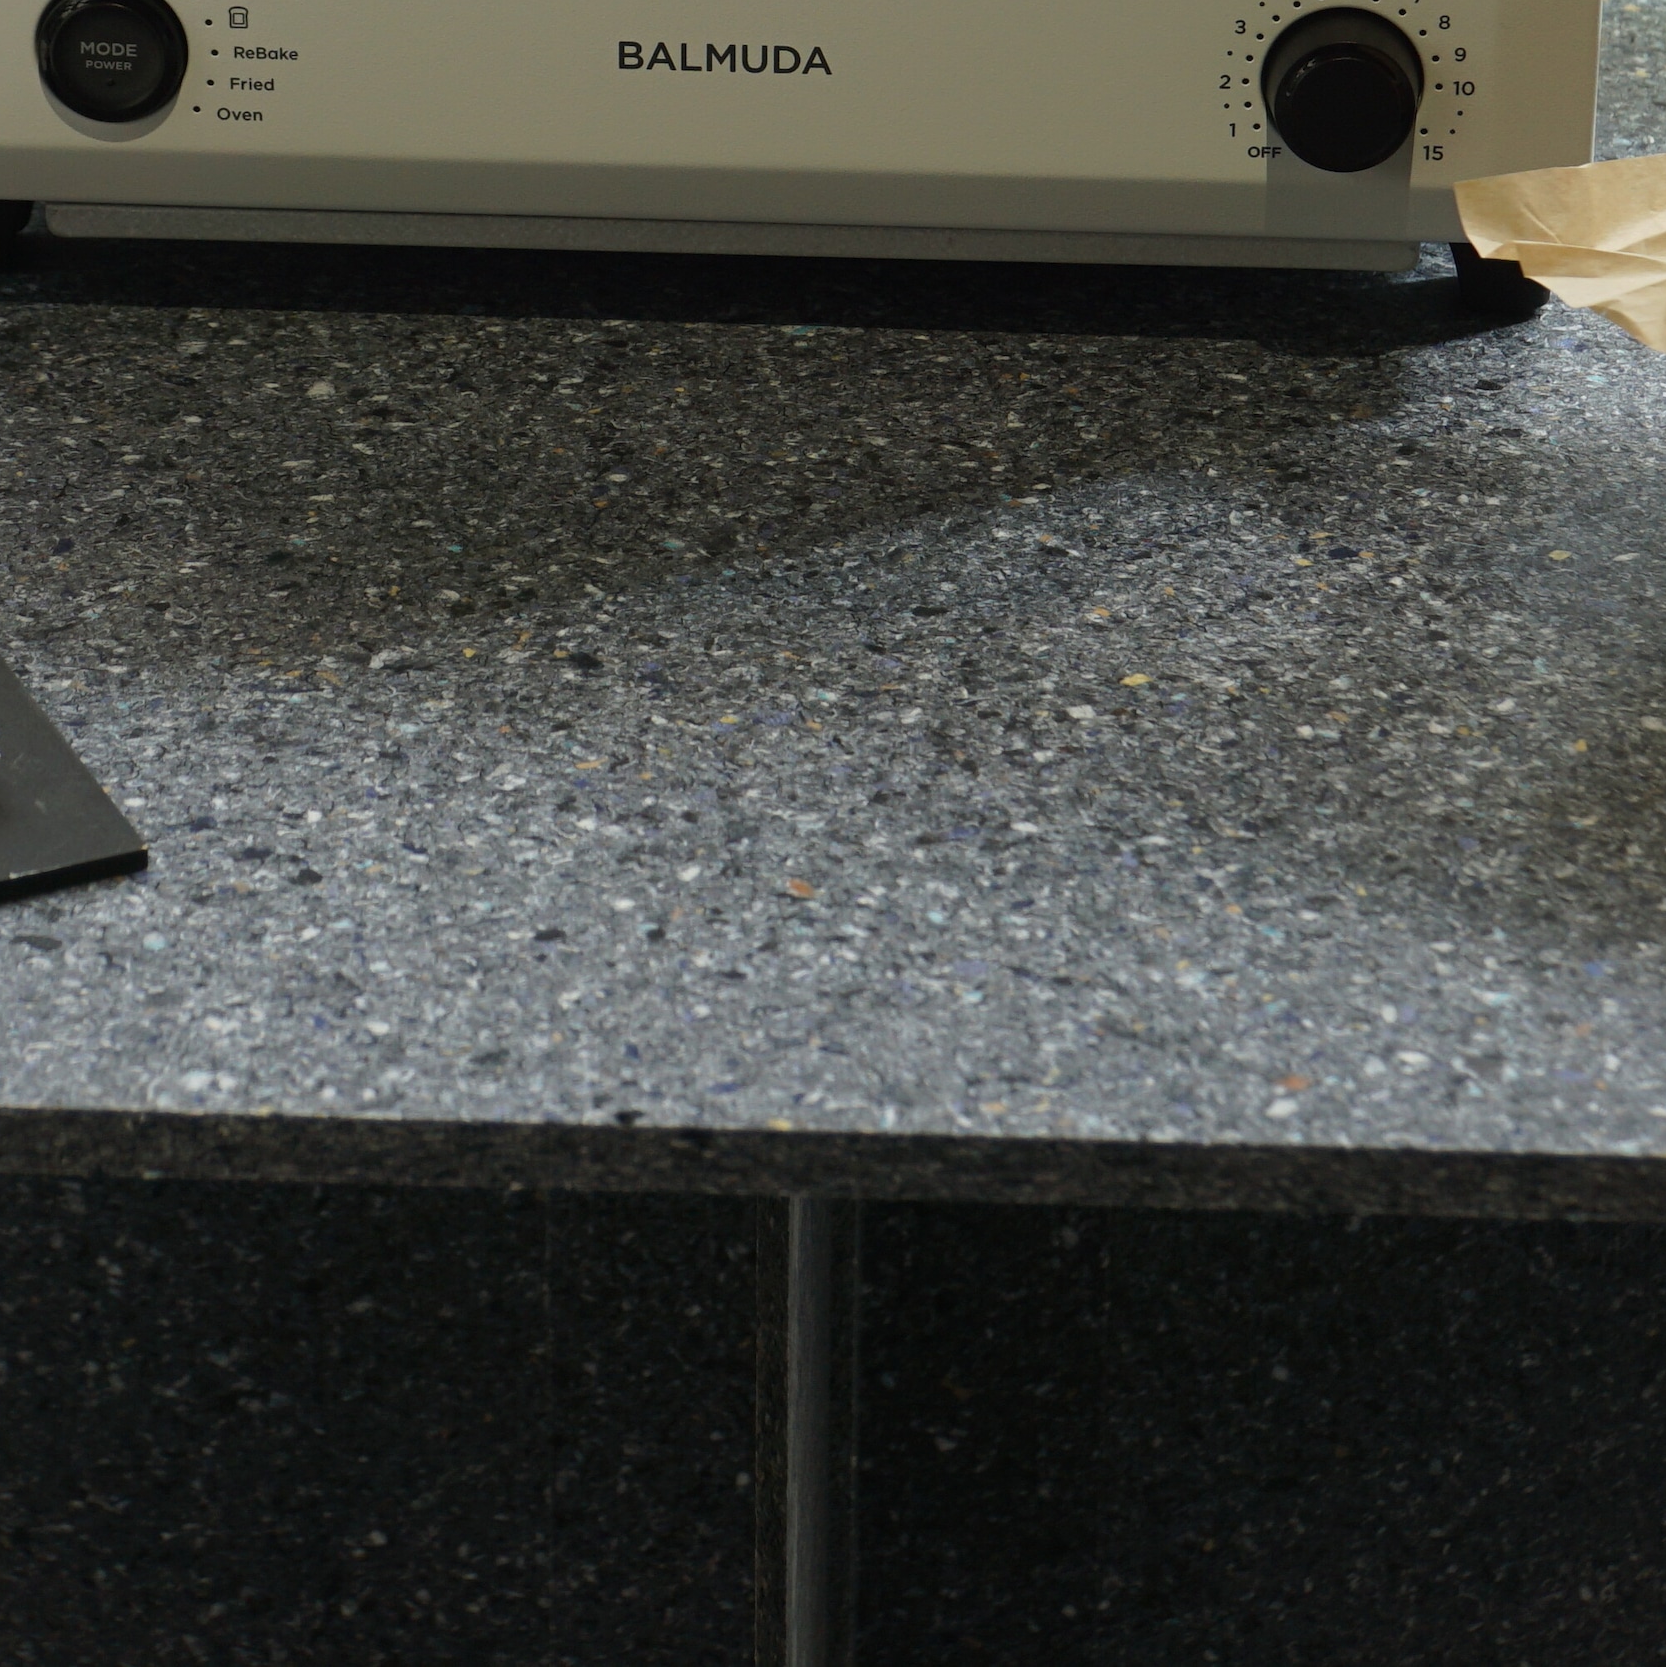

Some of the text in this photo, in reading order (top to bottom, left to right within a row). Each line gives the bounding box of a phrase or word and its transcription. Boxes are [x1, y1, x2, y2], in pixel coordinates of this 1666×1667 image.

[1234, 20, 1247, 35] 3
[1438, 15, 1451, 30] 8
[79, 40, 138, 58] MODE
[233, 46, 299, 61] ReBake
[1454, 47, 1467, 62] 9
[85, 59, 133, 72] POWER
[617, 40, 833, 76] BALMUDA
[229, 76, 276, 92] Fried
[1219, 75, 1232, 90] 2
[1452, 81, 1475, 97] 10
[216, 107, 264, 122] Oven
[1228, 123, 1237, 138] 1
[1247, 146, 1282, 159] OFF
[1422, 146, 1444, 161] 15
